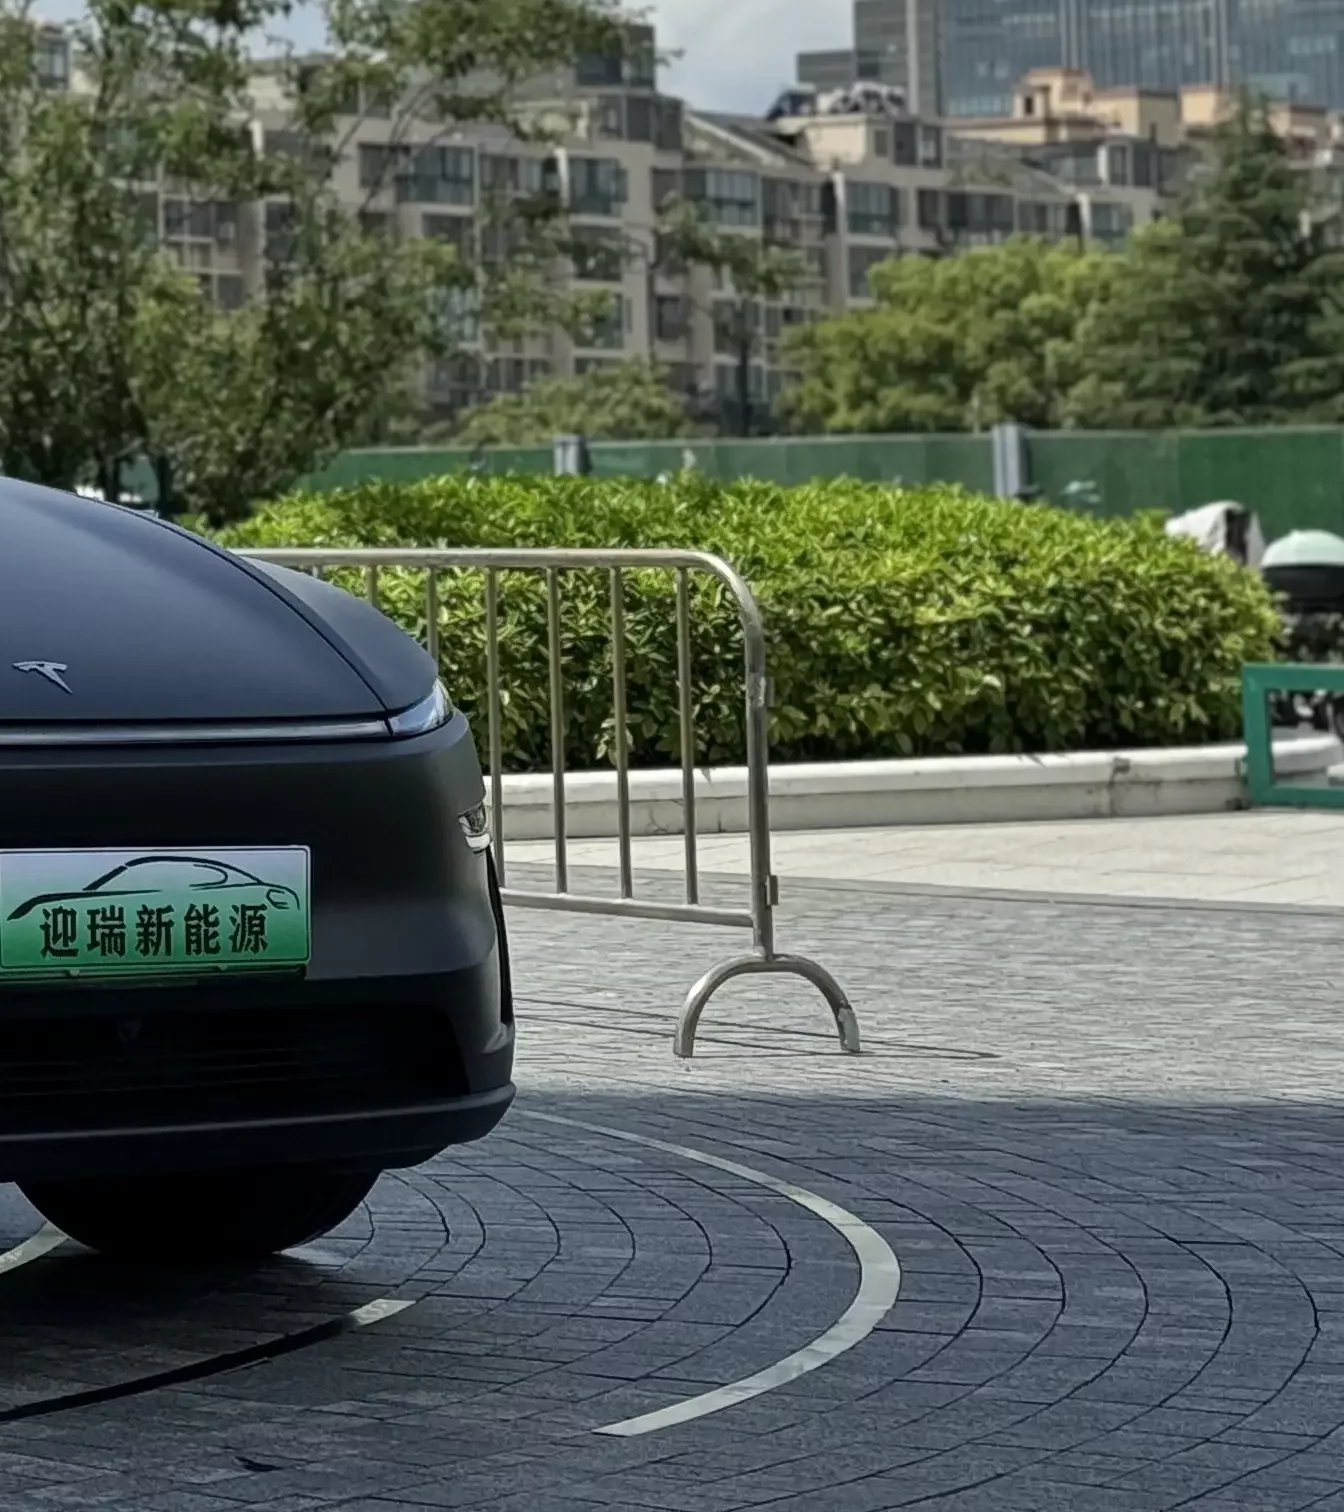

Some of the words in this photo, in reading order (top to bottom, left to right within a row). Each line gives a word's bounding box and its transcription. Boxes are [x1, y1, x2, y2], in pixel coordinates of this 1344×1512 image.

[39, 903, 269, 958] 迎瑞新能源
